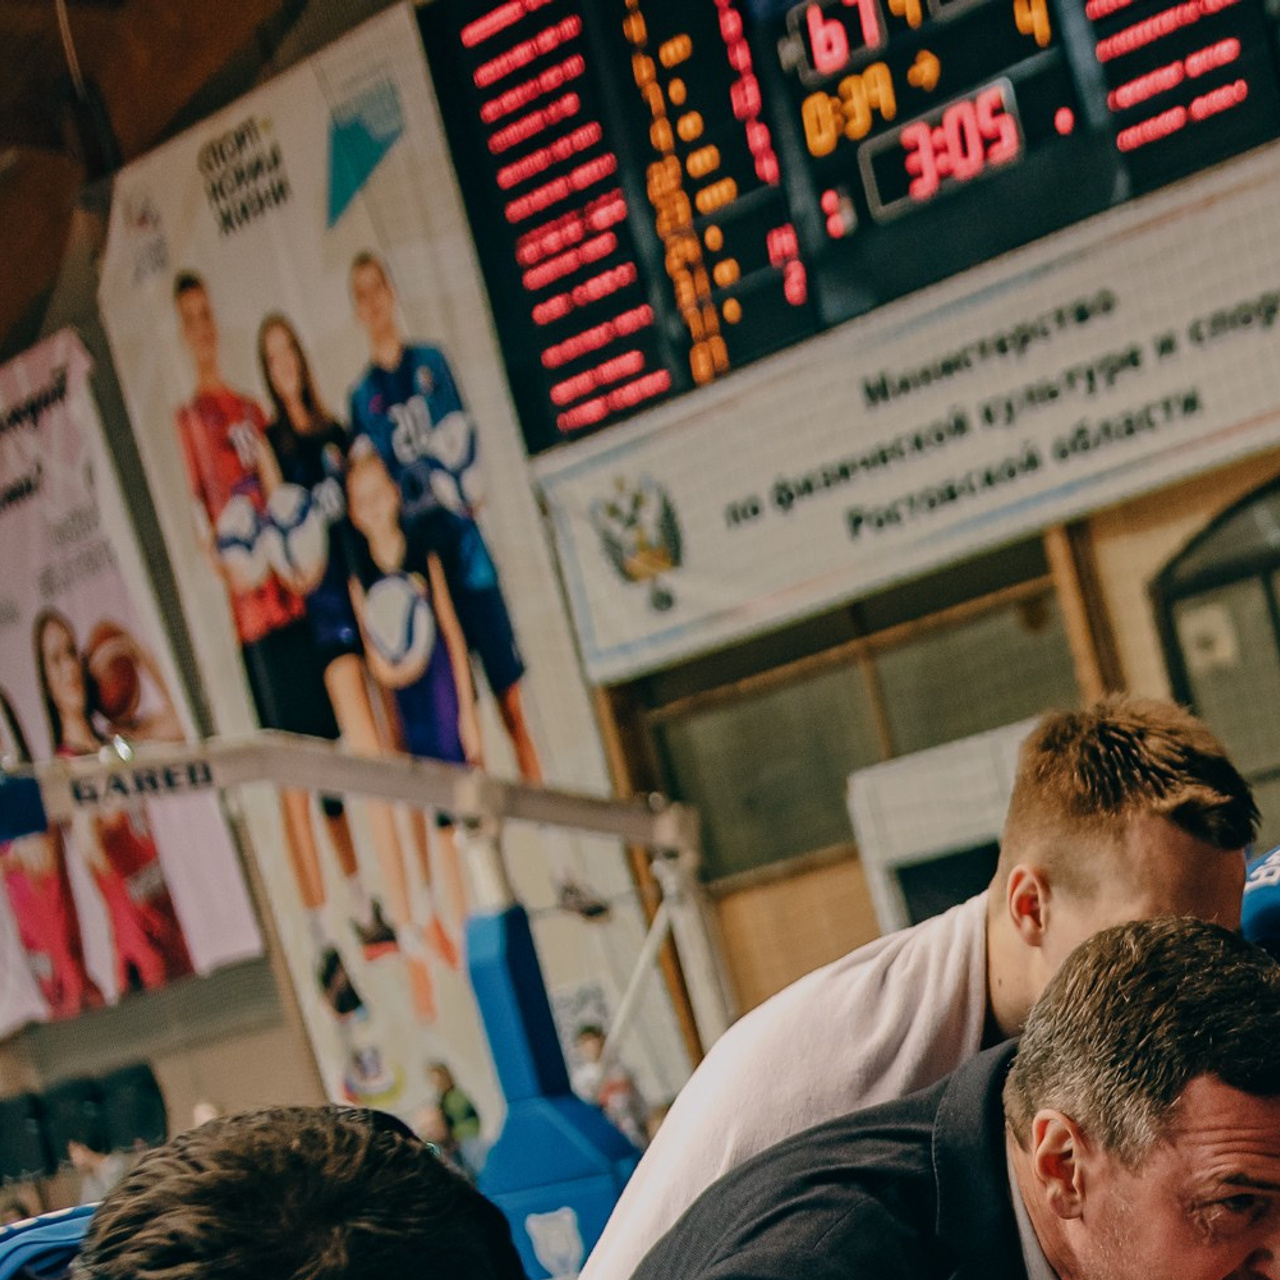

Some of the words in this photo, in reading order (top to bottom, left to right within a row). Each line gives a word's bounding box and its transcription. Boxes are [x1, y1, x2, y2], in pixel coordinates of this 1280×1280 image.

[900, 85, 1019, 200] 3:05
[725, 496, 761, 529] по
[771, 406, 970, 513] физической
[980, 343, 1142, 426] культуре
[1154, 329, 1178, 358] и
[846, 440, 1042, 540] Ростовской
[1053, 387, 1202, 460] области
